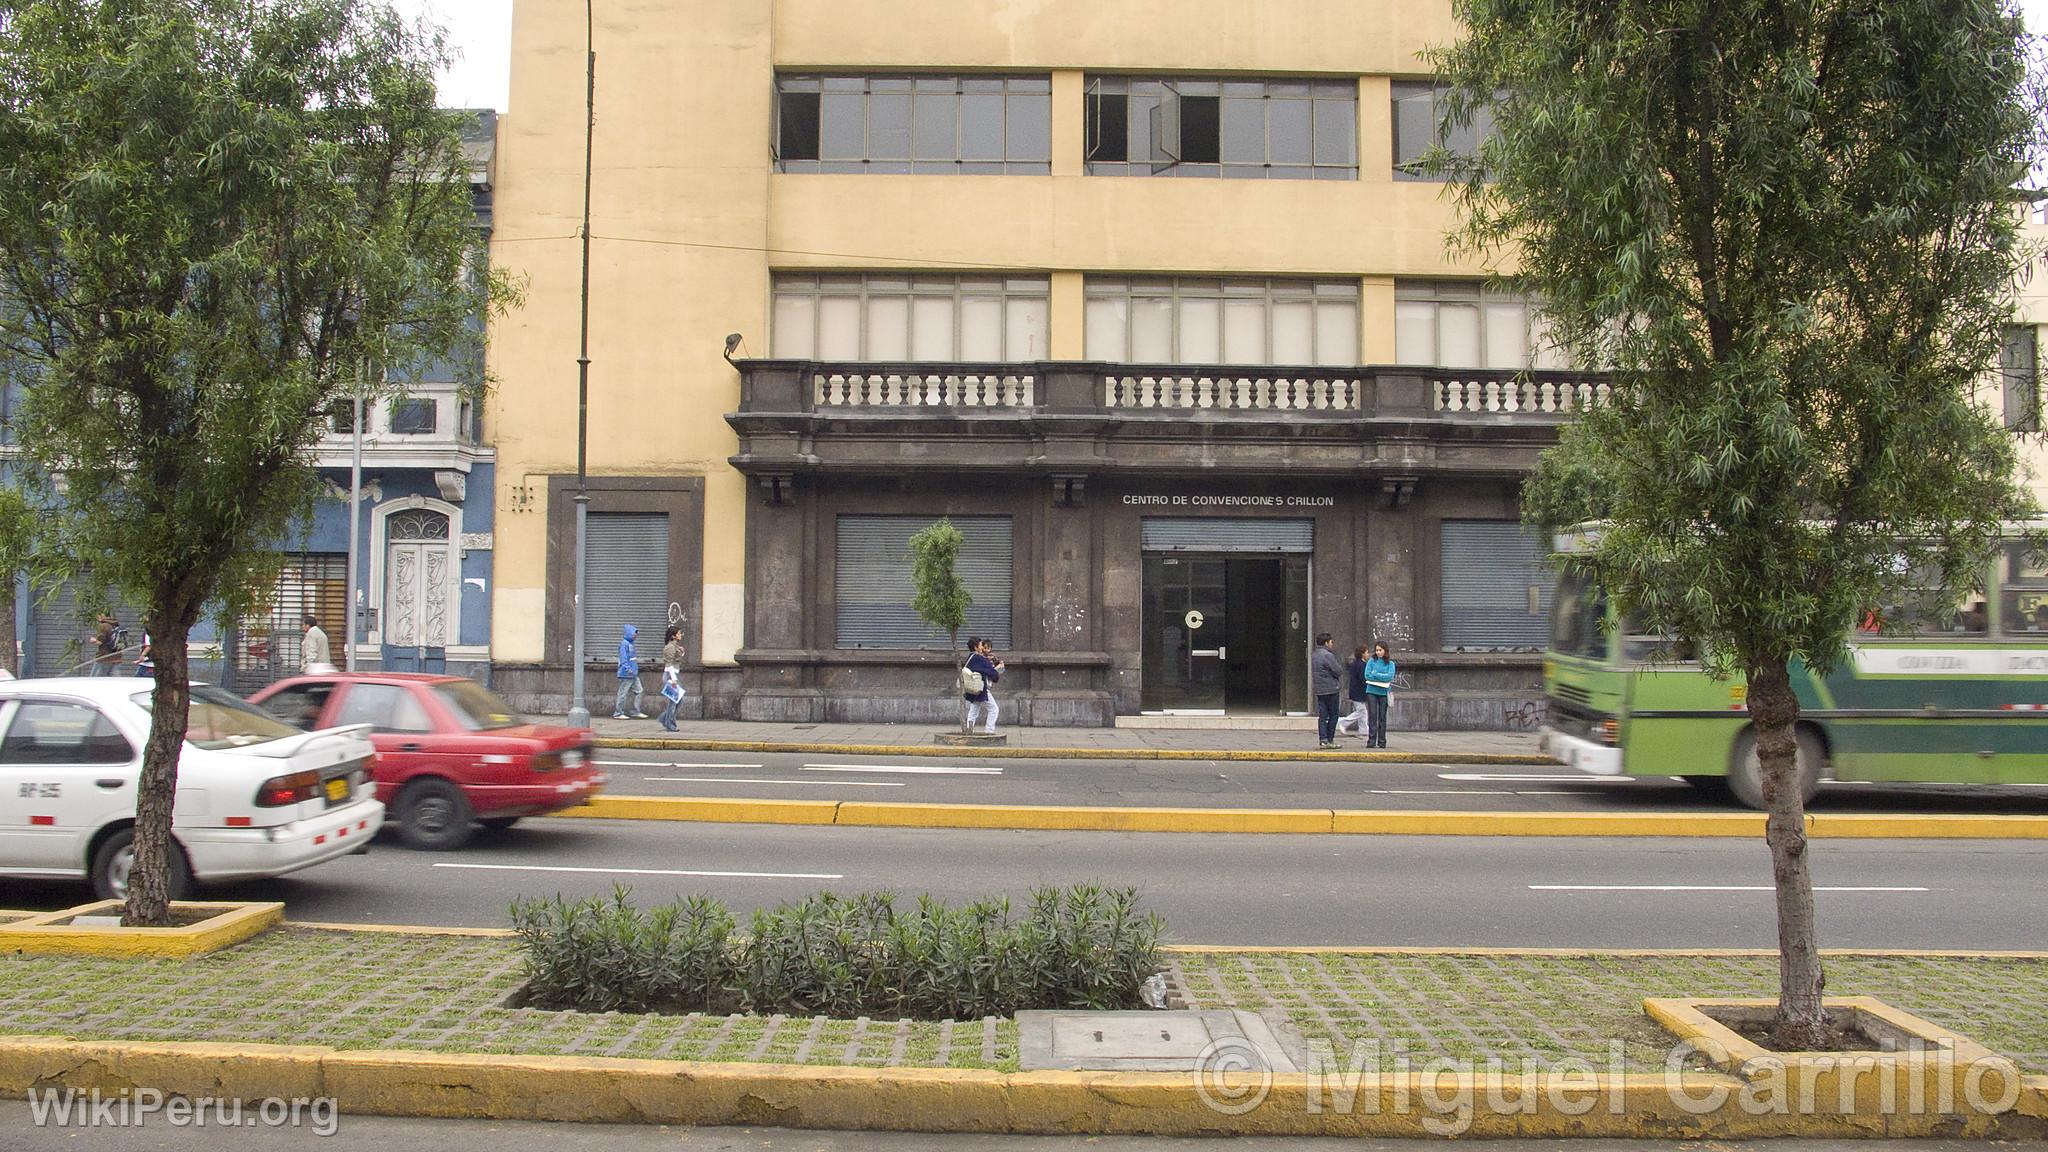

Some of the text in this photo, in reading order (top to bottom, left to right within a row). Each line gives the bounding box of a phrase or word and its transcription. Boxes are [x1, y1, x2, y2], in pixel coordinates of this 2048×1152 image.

[1122, 495, 1334, 506] CENTRO DE CONVENCIONES CRILLON
